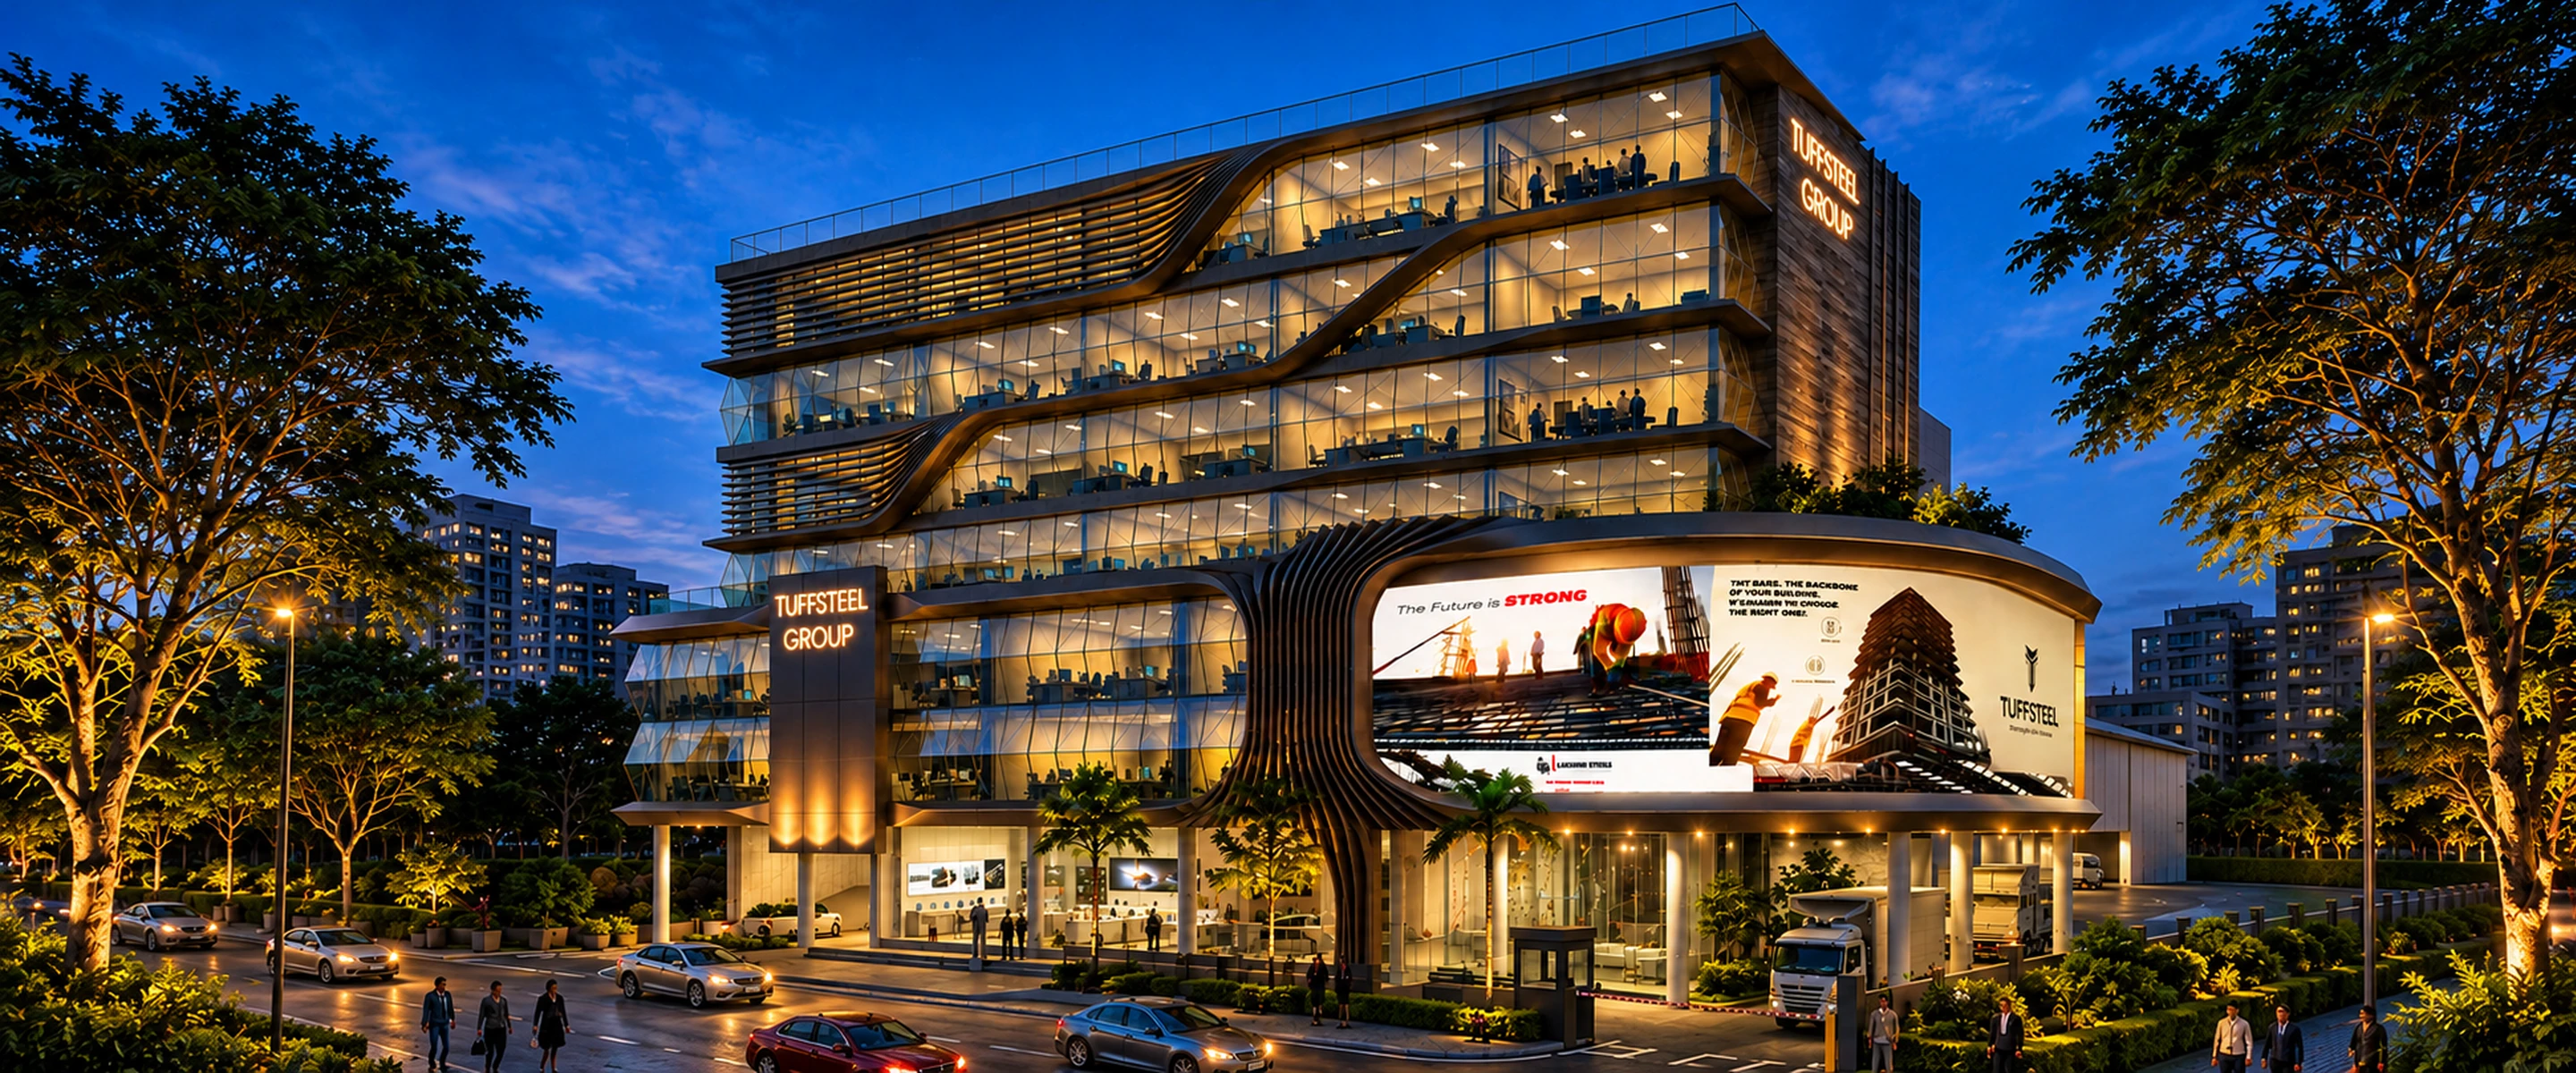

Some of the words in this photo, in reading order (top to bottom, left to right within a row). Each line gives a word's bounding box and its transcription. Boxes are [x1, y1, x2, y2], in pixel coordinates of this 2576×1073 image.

[1791, 118, 1860, 205] TUFFSTEEL
[1801, 178, 1853, 240] GROUP
[1806, 581, 1859, 591] BACKBONE
[775, 588, 869, 618] TUFFSTEEL
[1397, 604, 1426, 614] The
[1430, 602, 1483, 613] Future
[1487, 598, 1500, 608] is
[1504, 589, 1588, 607] STRONG
[784, 623, 854, 650] GROUP
[2000, 696, 2059, 727] TUFFSTEEL
